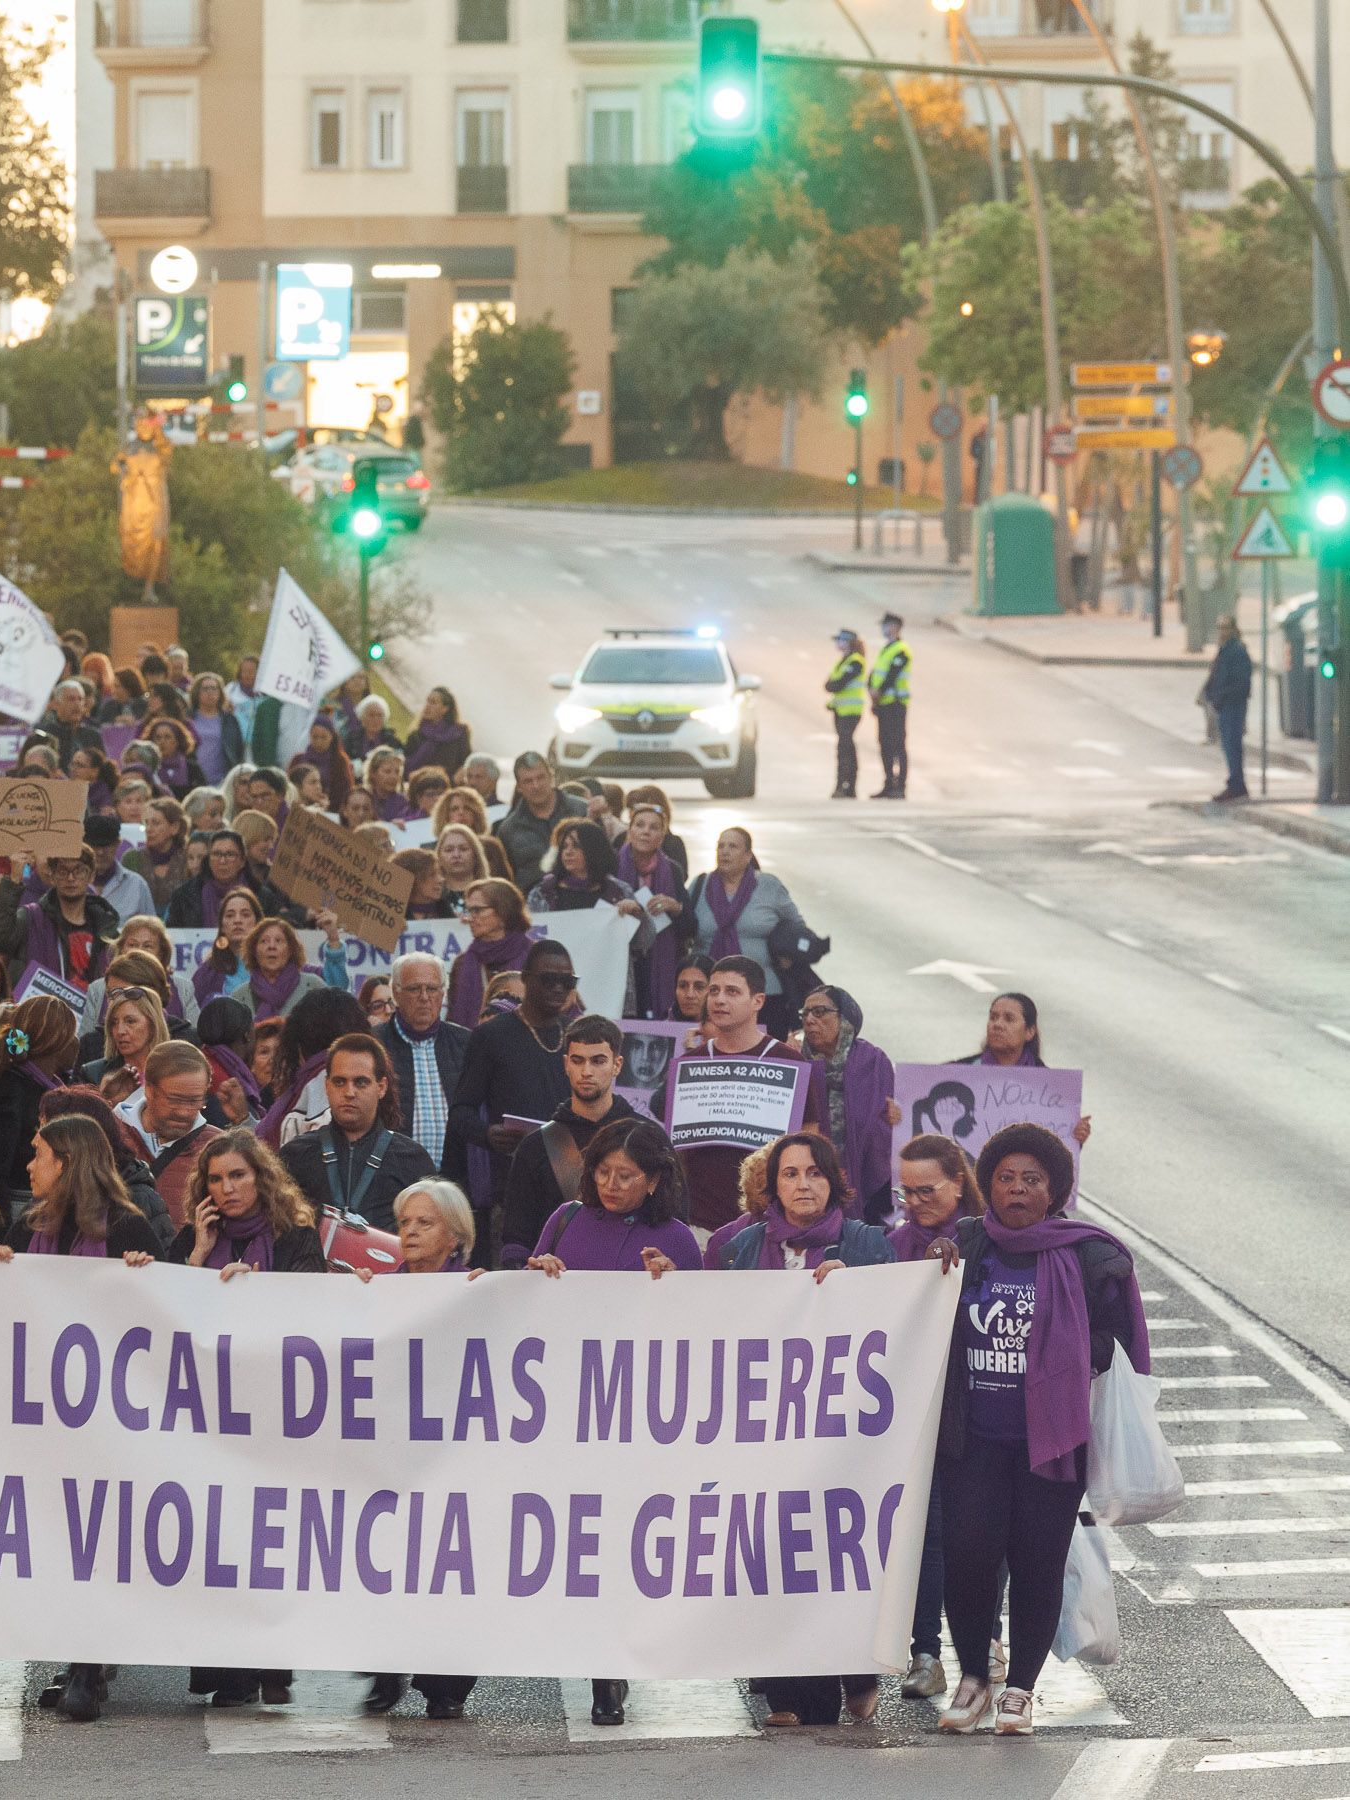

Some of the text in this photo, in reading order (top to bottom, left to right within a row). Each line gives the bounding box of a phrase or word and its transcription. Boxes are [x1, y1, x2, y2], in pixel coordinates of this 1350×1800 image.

[137, 300, 172, 344] P
[280, 287, 324, 342] P
[371, 864, 392, 886] NO
[36, 973, 85, 1008] MERCEDES
[688, 1066, 784, 1081] VANESA 42 AÑOS
[678, 1084, 709, 1093] Asesinada
[672, 1127, 778, 1142] STOP VIOLENCIA MACHIST
[992, 1336, 1025, 1351] nos
[11, 1322, 251, 1436] LOCAL
[281, 1335, 375, 1440] DE
[409, 1336, 546, 1444] LAS
[576, 1329, 895, 1445] MUJERES
[62, 1477, 476, 1597] VIOLENCIA
[507, 1491, 603, 1598] DE
